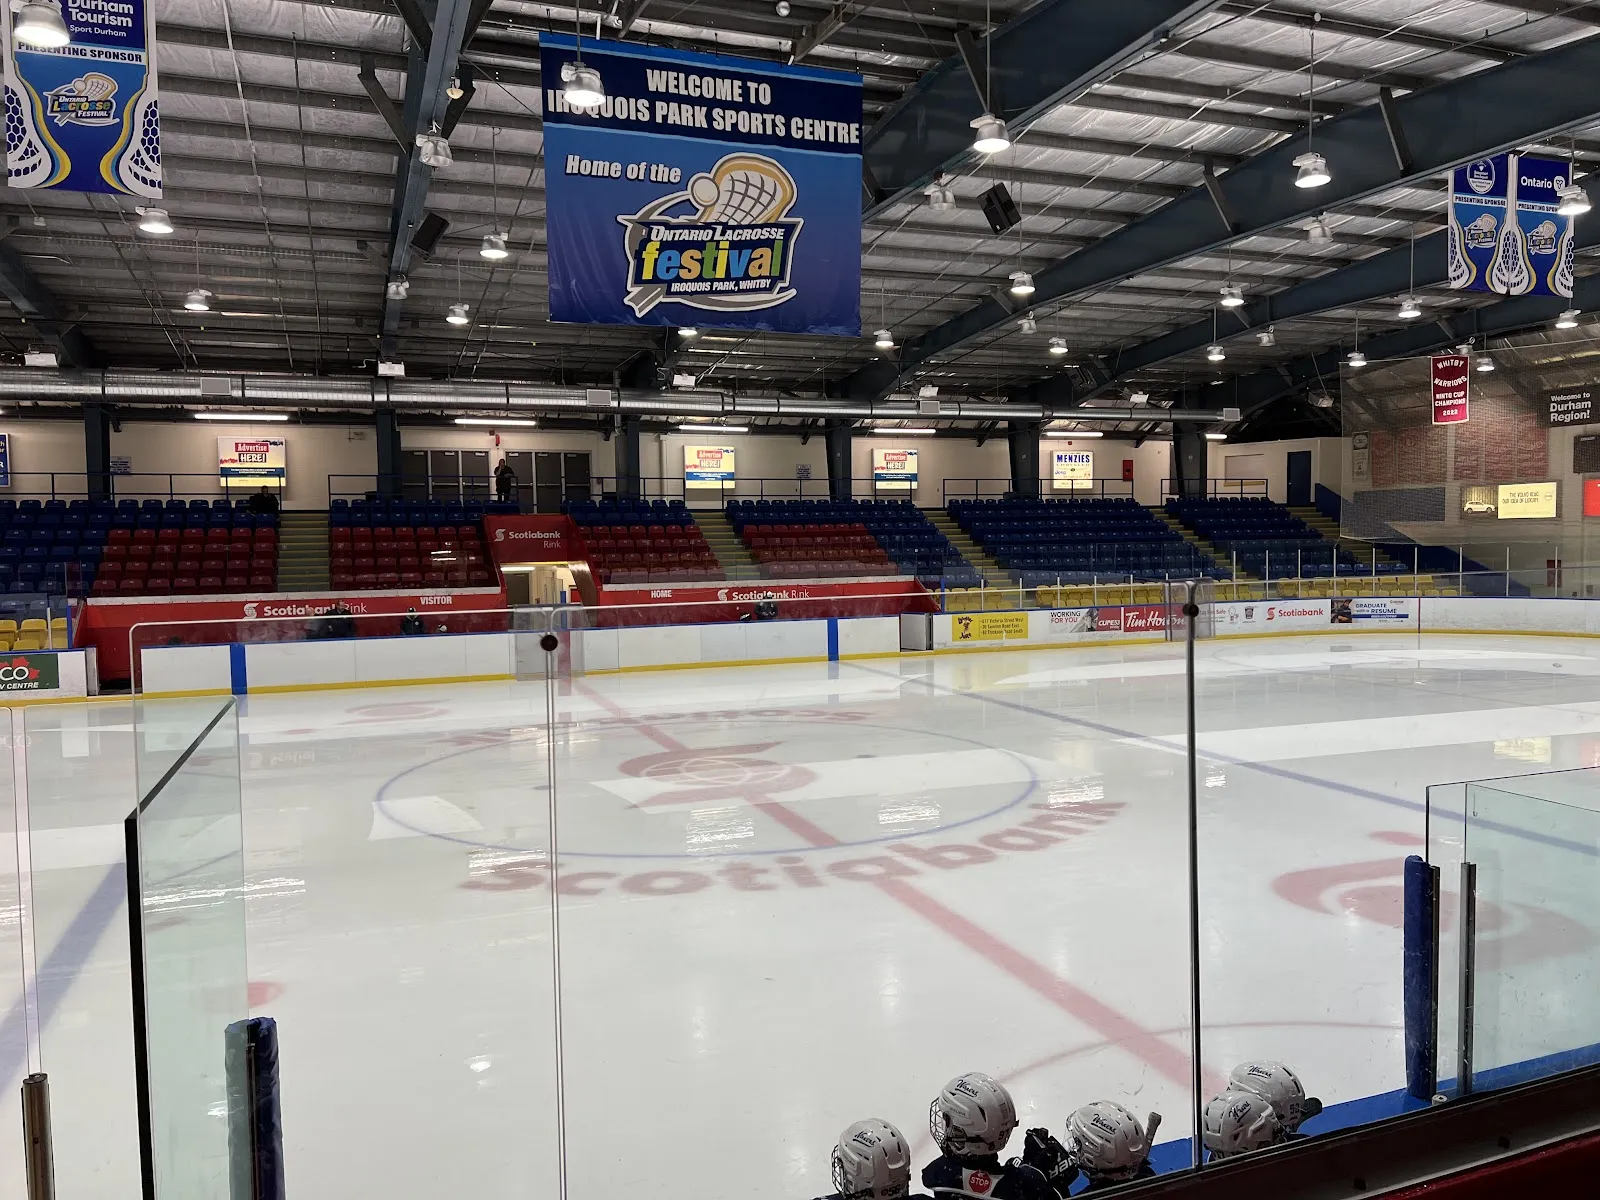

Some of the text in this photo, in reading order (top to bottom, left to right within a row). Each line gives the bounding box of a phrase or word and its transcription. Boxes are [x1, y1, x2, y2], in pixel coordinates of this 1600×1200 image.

[68, 0, 134, 14] Durham
[68, 8, 132, 27] Tourism
[70, 25, 126, 37] Sport Durham
[90, 49, 142, 62] SPONSOR
[646, 69, 771, 105] WELCOME TO
[53, 101, 111, 111] Lacrosse
[655, 101, 708, 128] PARK
[712, 109, 786, 137] SPORTS
[790, 117, 860, 144] CENTRE
[566, 155, 682, 183] Home of the
[1521, 176, 1552, 189] Ontario
[650, 225, 785, 241] ONTARIO LACROSSE
[642, 240, 783, 280] festival
[671, 279, 771, 292] IROQUOIS PARK, WHITBY
[1437, 359, 1464, 369] WHITBY
[1434, 376, 1467, 387] WARRIORS
[1435, 398, 1465, 406] CHAMPIONS
[1550, 401, 1591, 412] Durham
[1551, 410, 1590, 422] Region!
[238, 443, 267, 451] Advertise
[240, 454, 265, 462] HERE!
[1057, 454, 1090, 463] MENZIES
[701, 460, 720, 468] HERE!
[509, 531, 560, 539] Scotiabank
[651, 590, 672, 598] HOME
[791, 589, 809, 599] Rink
[420, 596, 452, 605] VISITOR
[264, 604, 335, 616] Scotiaan
[1278, 608, 1324, 617] Scotiabank
[1126, 612, 1146, 627] Tim
[1147, 611, 1184, 627] Horton
[456, 800, 1127, 897] Scotiabank
[970, 1176, 989, 1186] STOP
